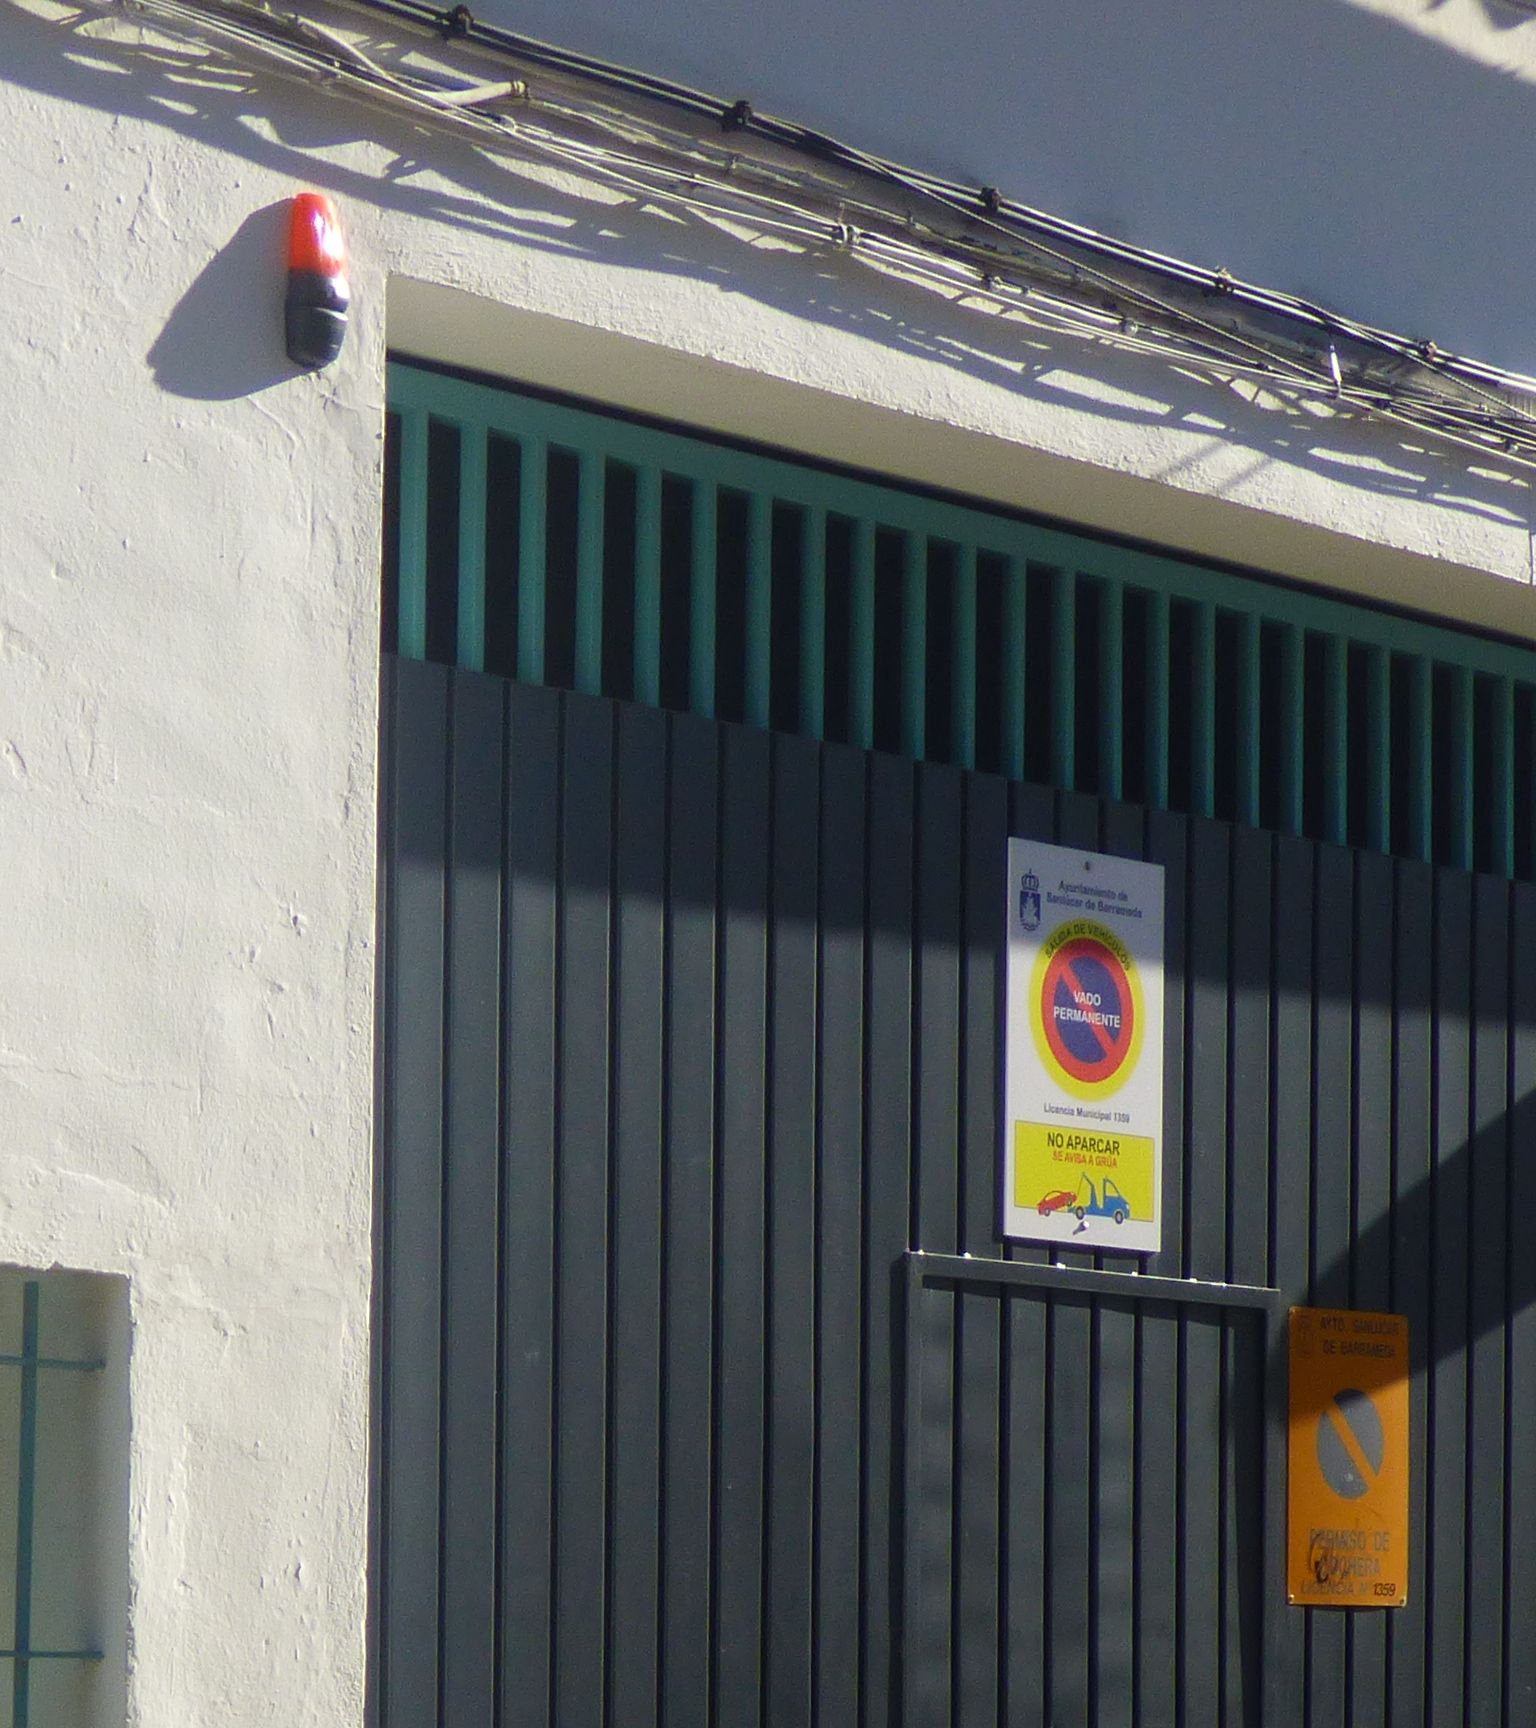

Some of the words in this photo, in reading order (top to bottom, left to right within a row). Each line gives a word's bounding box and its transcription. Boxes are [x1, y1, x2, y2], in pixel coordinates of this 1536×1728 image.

[1085, 900, 1096, 911] de
[1073, 923, 1086, 935] DE
[1074, 990, 1101, 1006] VADO
[1054, 1006, 1120, 1028] PERMANENTE
[1044, 1103, 1075, 1116] Licencia
[1076, 1107, 1111, 1121] Municipal
[1048, 1132, 1064, 1148] NO
[1066, 1135, 1120, 1156] APARCAR
[1375, 1531, 1390, 1552] DE
[1374, 1583, 1396, 1597] 1359
